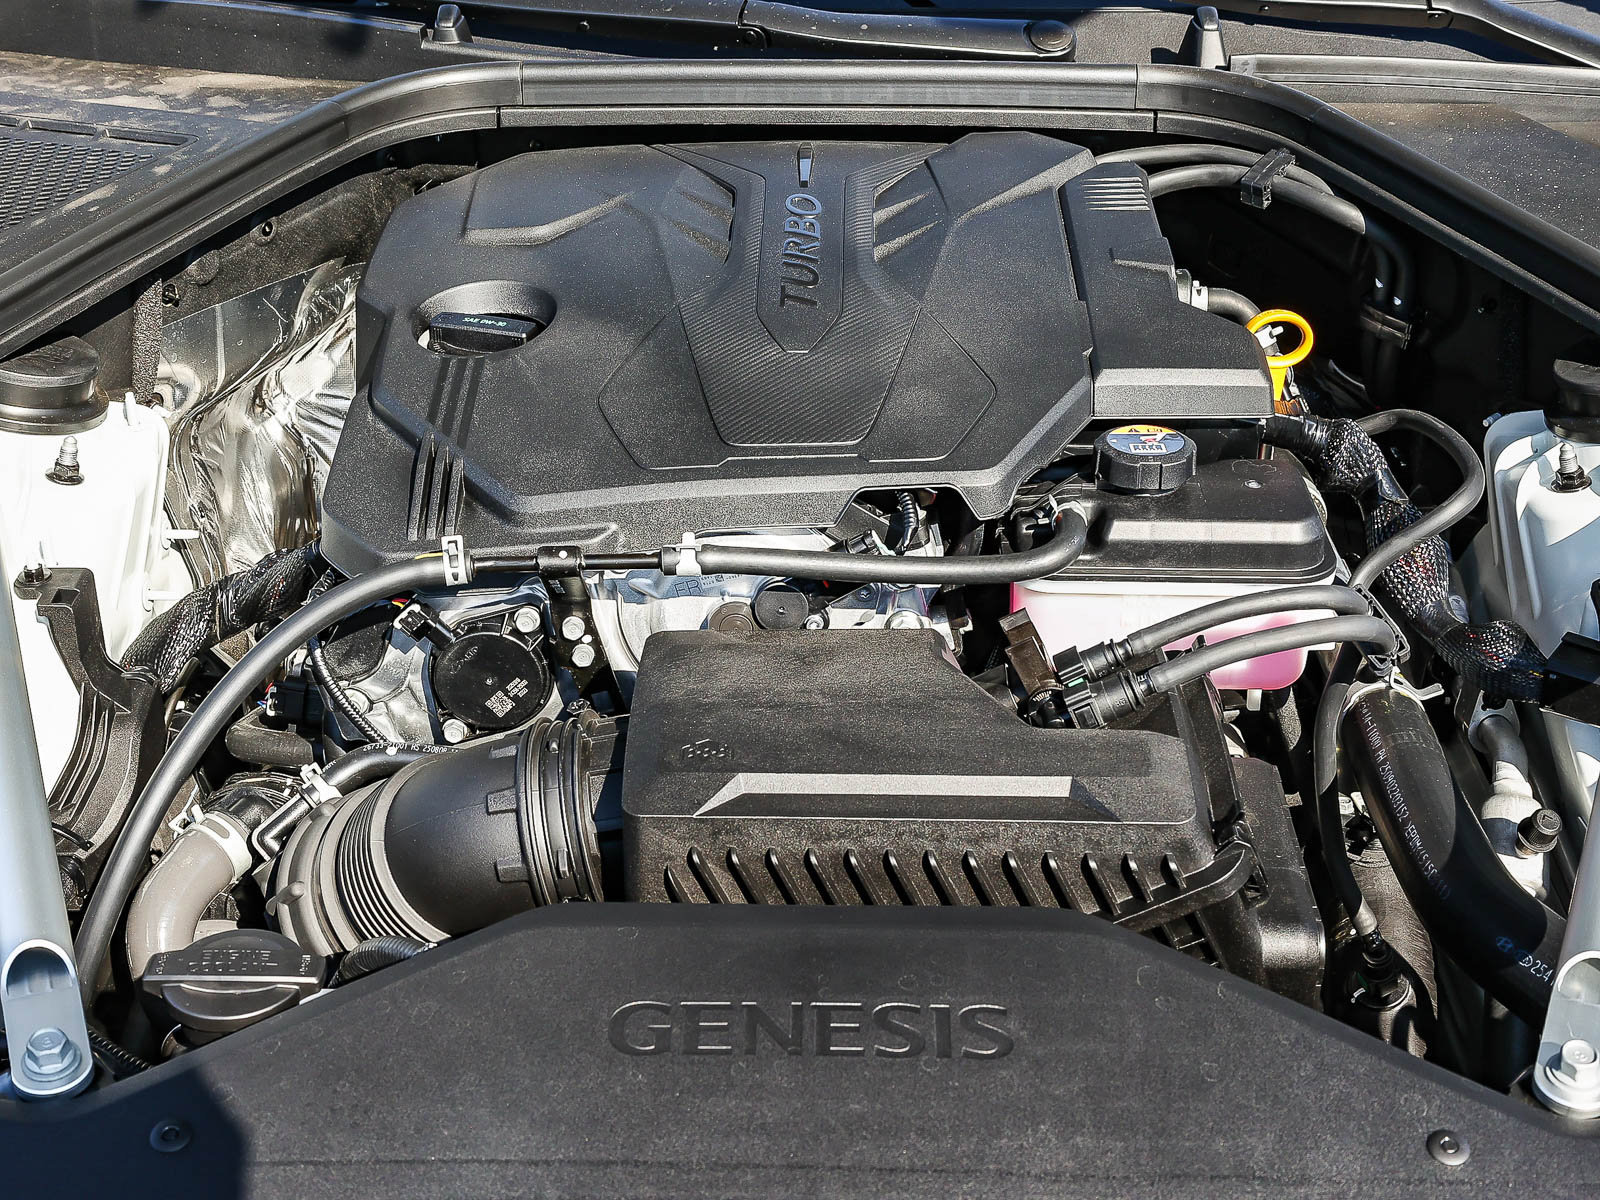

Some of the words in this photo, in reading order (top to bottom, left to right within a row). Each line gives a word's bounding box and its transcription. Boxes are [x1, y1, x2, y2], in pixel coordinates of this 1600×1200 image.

[780, 193, 822, 307] TURBO
[674, 580, 704, 597] FR
[1374, 749, 1388, 763] PH
[607, 1001, 1014, 1059] GENESIS
